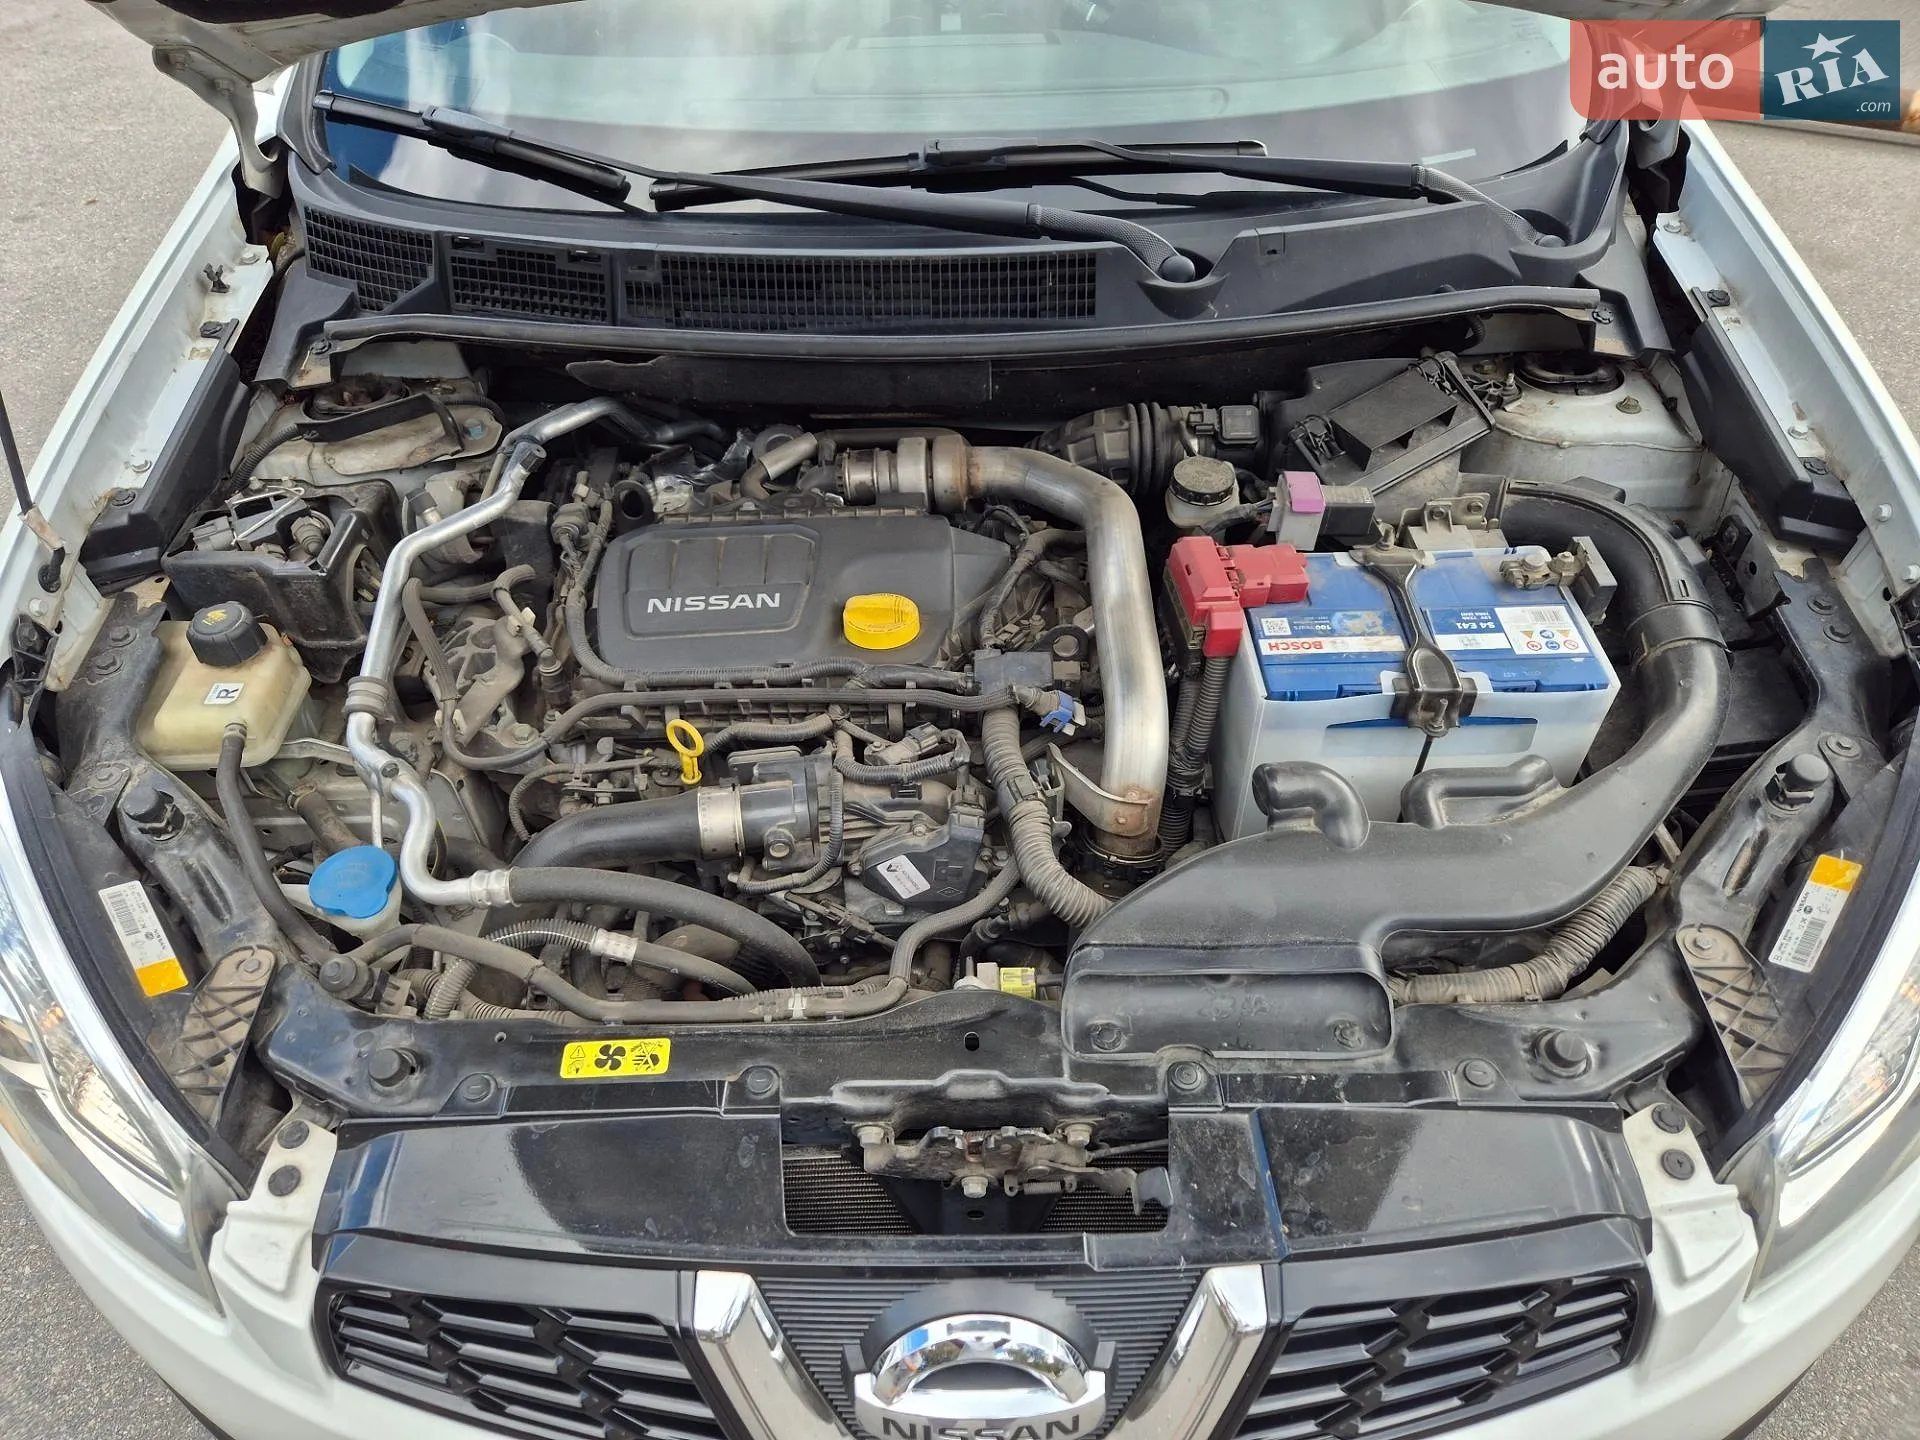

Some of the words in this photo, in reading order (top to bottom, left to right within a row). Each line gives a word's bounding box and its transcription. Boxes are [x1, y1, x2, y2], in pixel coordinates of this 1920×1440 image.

[647, 592, 781, 613] NISSAN
[1479, 621, 1496, 629] S4
[1268, 640, 1324, 651] BOSCH
[882, 1414, 1080, 1440] NISSAN
